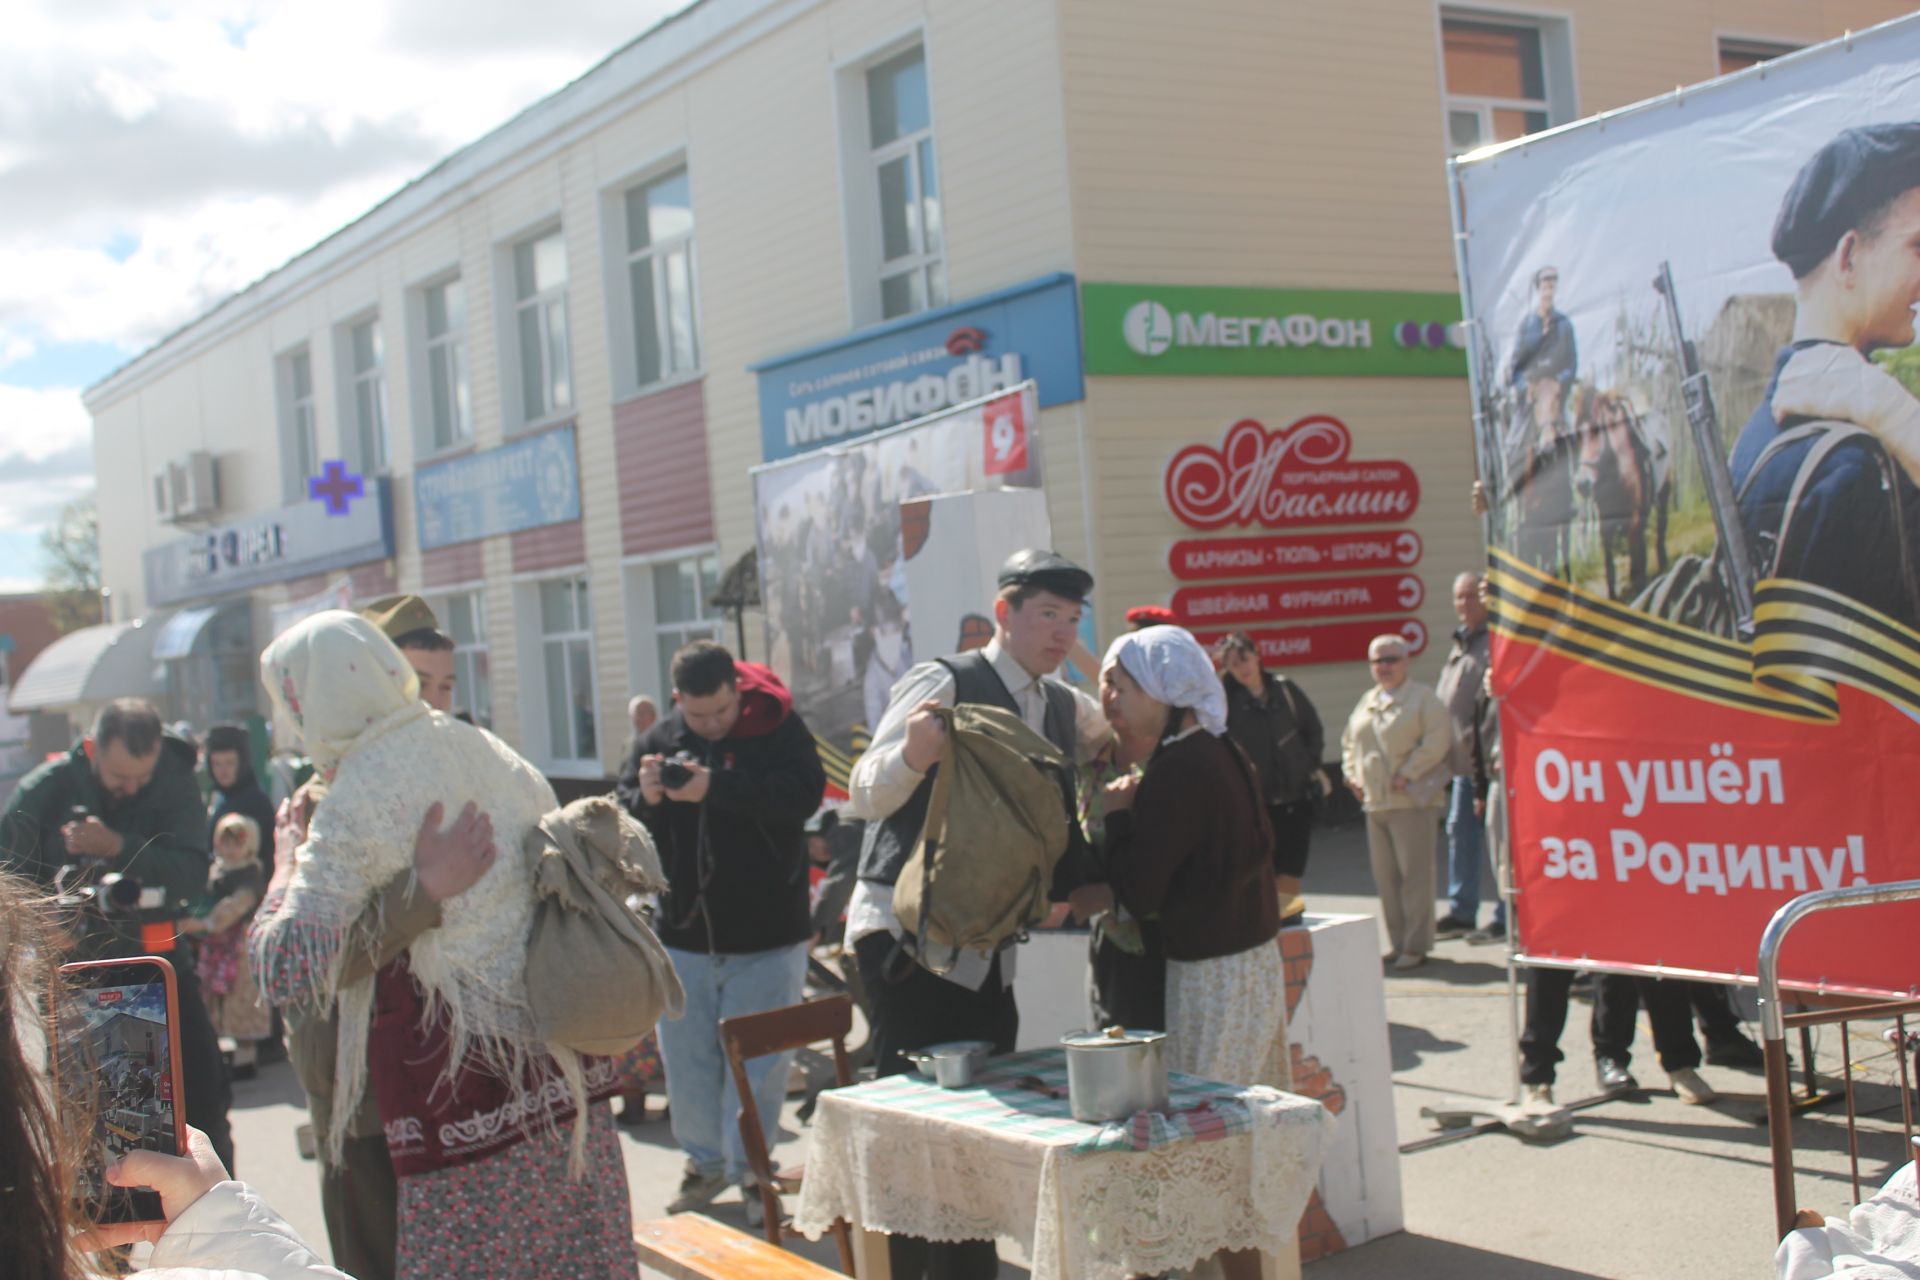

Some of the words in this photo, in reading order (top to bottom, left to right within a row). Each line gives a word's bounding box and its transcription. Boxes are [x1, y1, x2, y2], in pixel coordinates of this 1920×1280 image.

[785, 353, 1022, 447] МОБИФОН
[991, 415, 1016, 462] 9
[1185, 548, 1264, 569] КАРНИЗЫ
[1275, 545, 1321, 564] ТЮЛЬ
[1332, 542, 1392, 561] ШТОРЫ
[1187, 593, 1270, 616] ШВЕЙНАЯ
[1279, 588, 1371, 609] ФУРНИТУРА
[1260, 638, 1311, 656] ТКАНИ
[1535, 748, 1605, 803] Он
[1616, 742, 1785, 818] ушёл
[1540, 837, 1598, 880] за
[1609, 829, 1869, 896] Родину!
